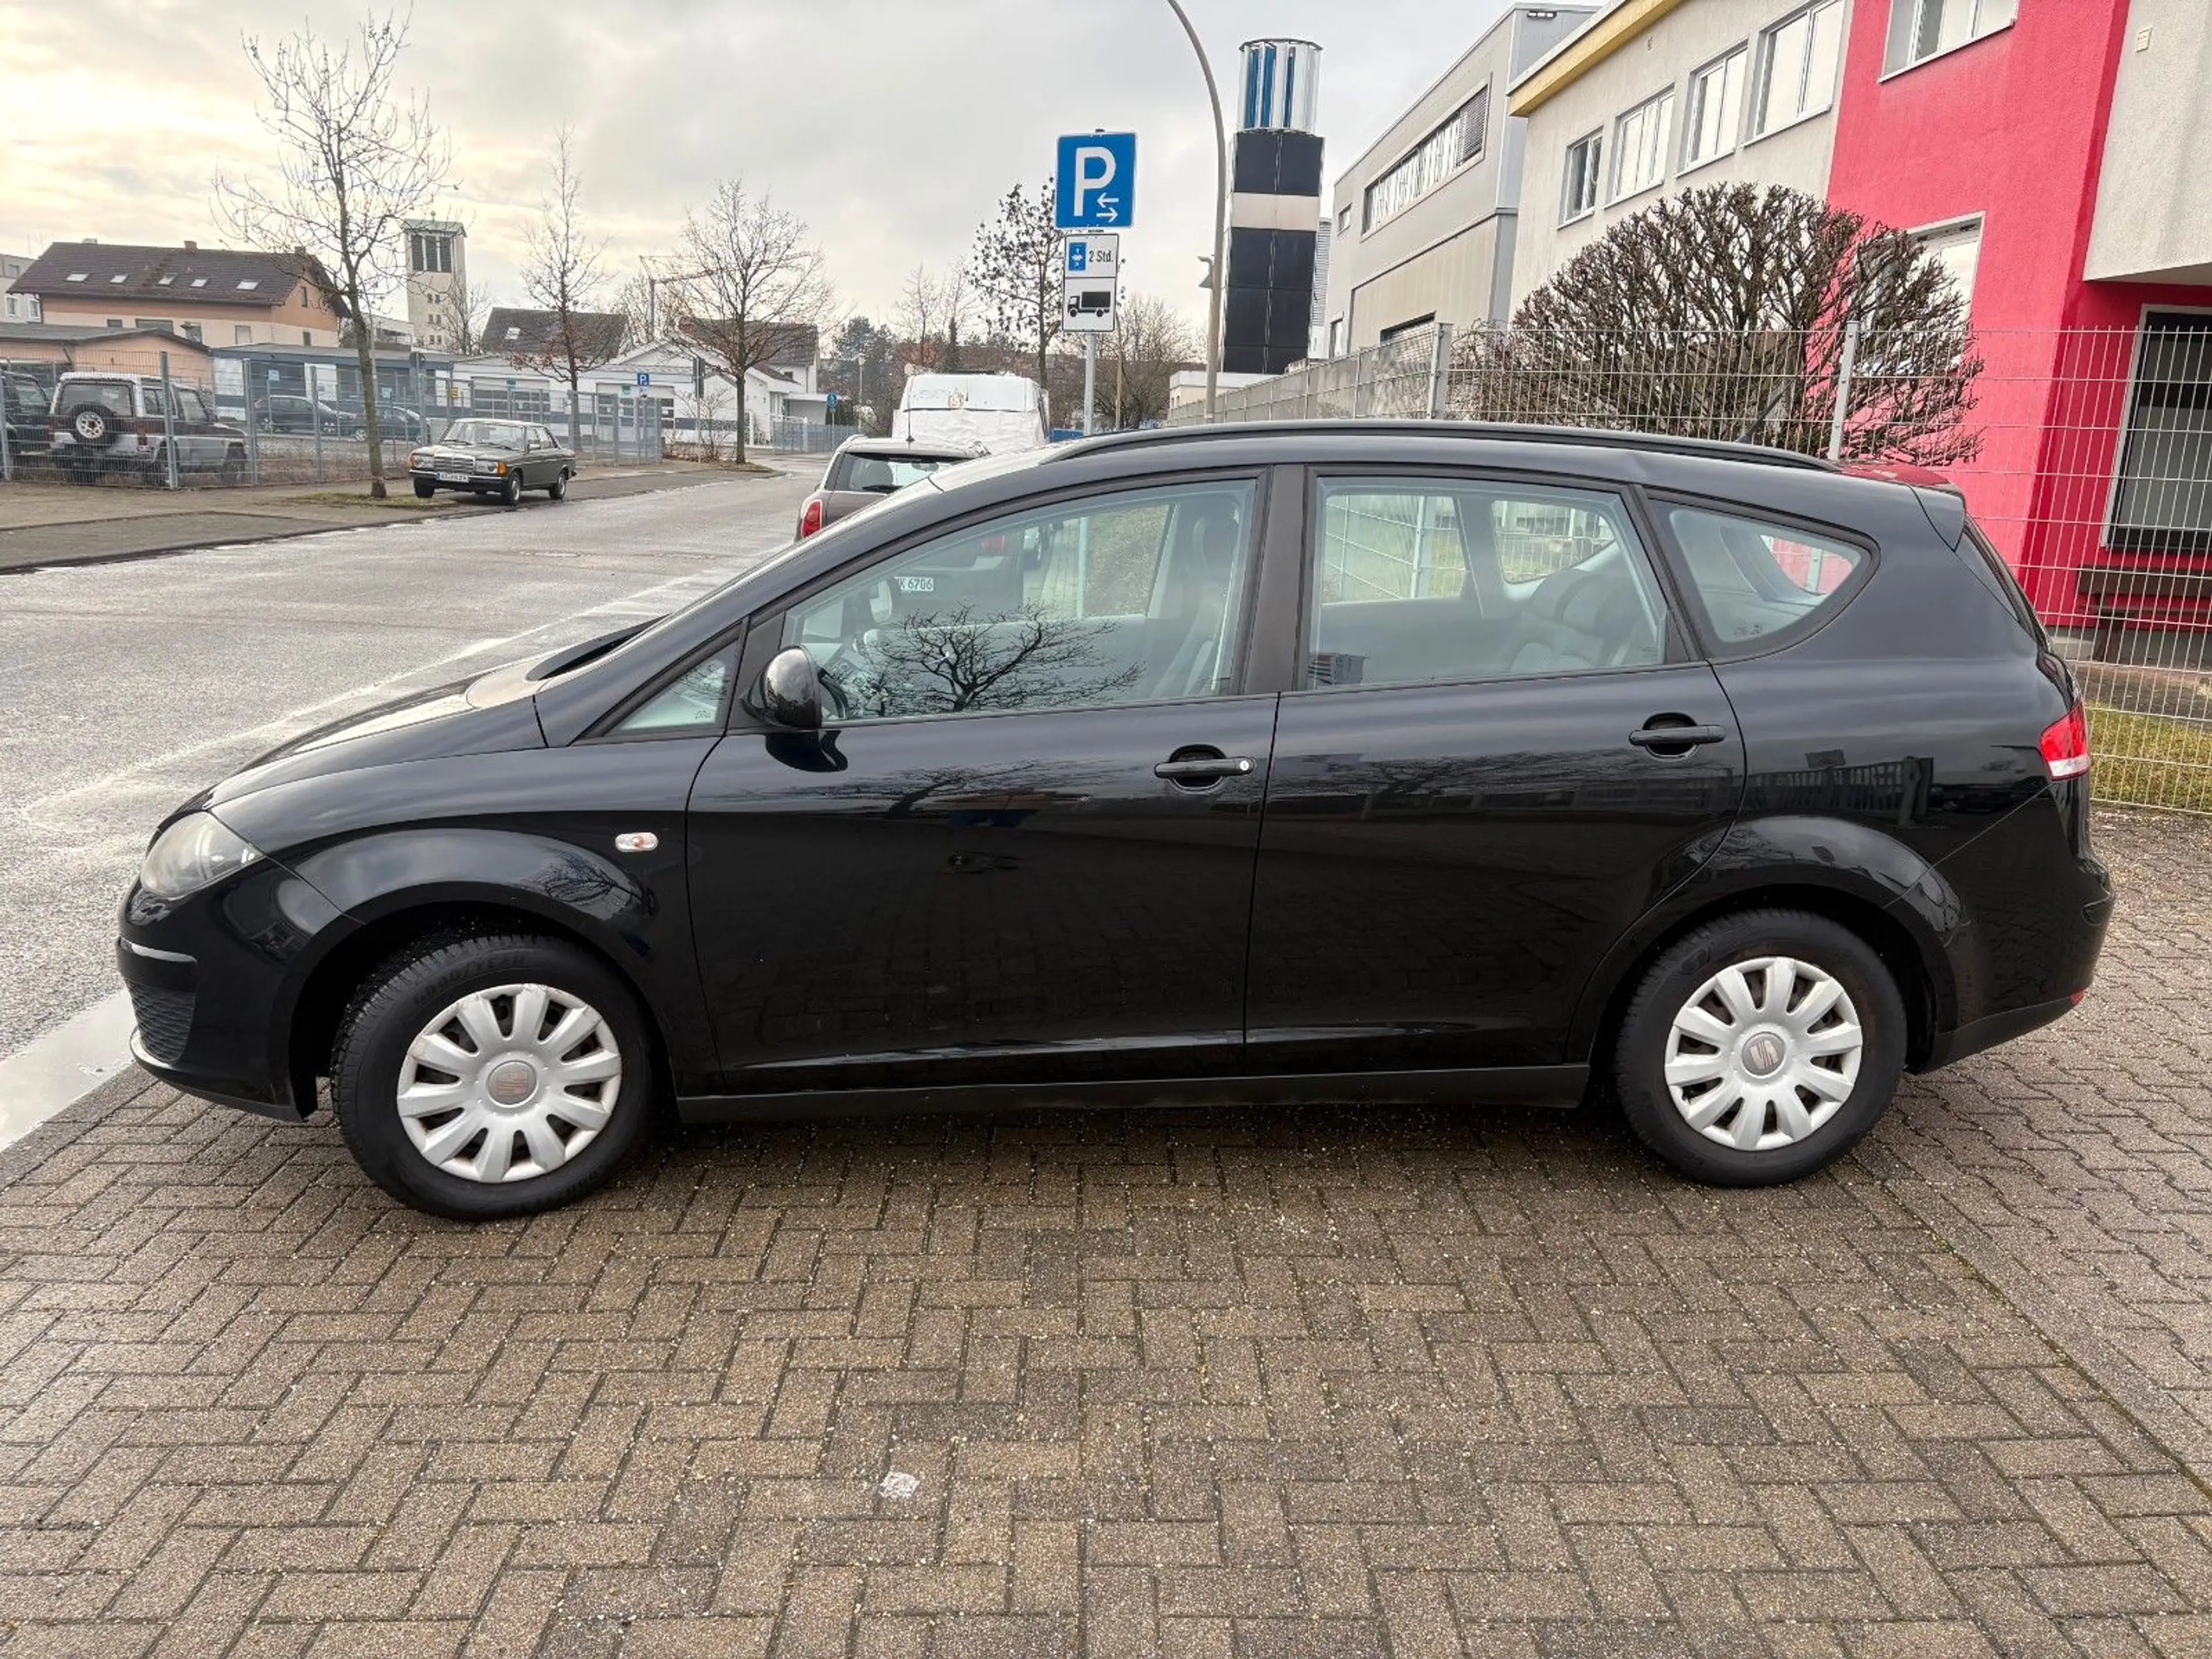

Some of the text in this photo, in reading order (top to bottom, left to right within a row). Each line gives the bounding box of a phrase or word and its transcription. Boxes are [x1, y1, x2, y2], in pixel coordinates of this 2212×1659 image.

[1074, 146, 1116, 217] P
[1089, 250, 1113, 263] 2 Std.
[639, 374, 647, 385] P
[908, 578, 932, 590] 6706
